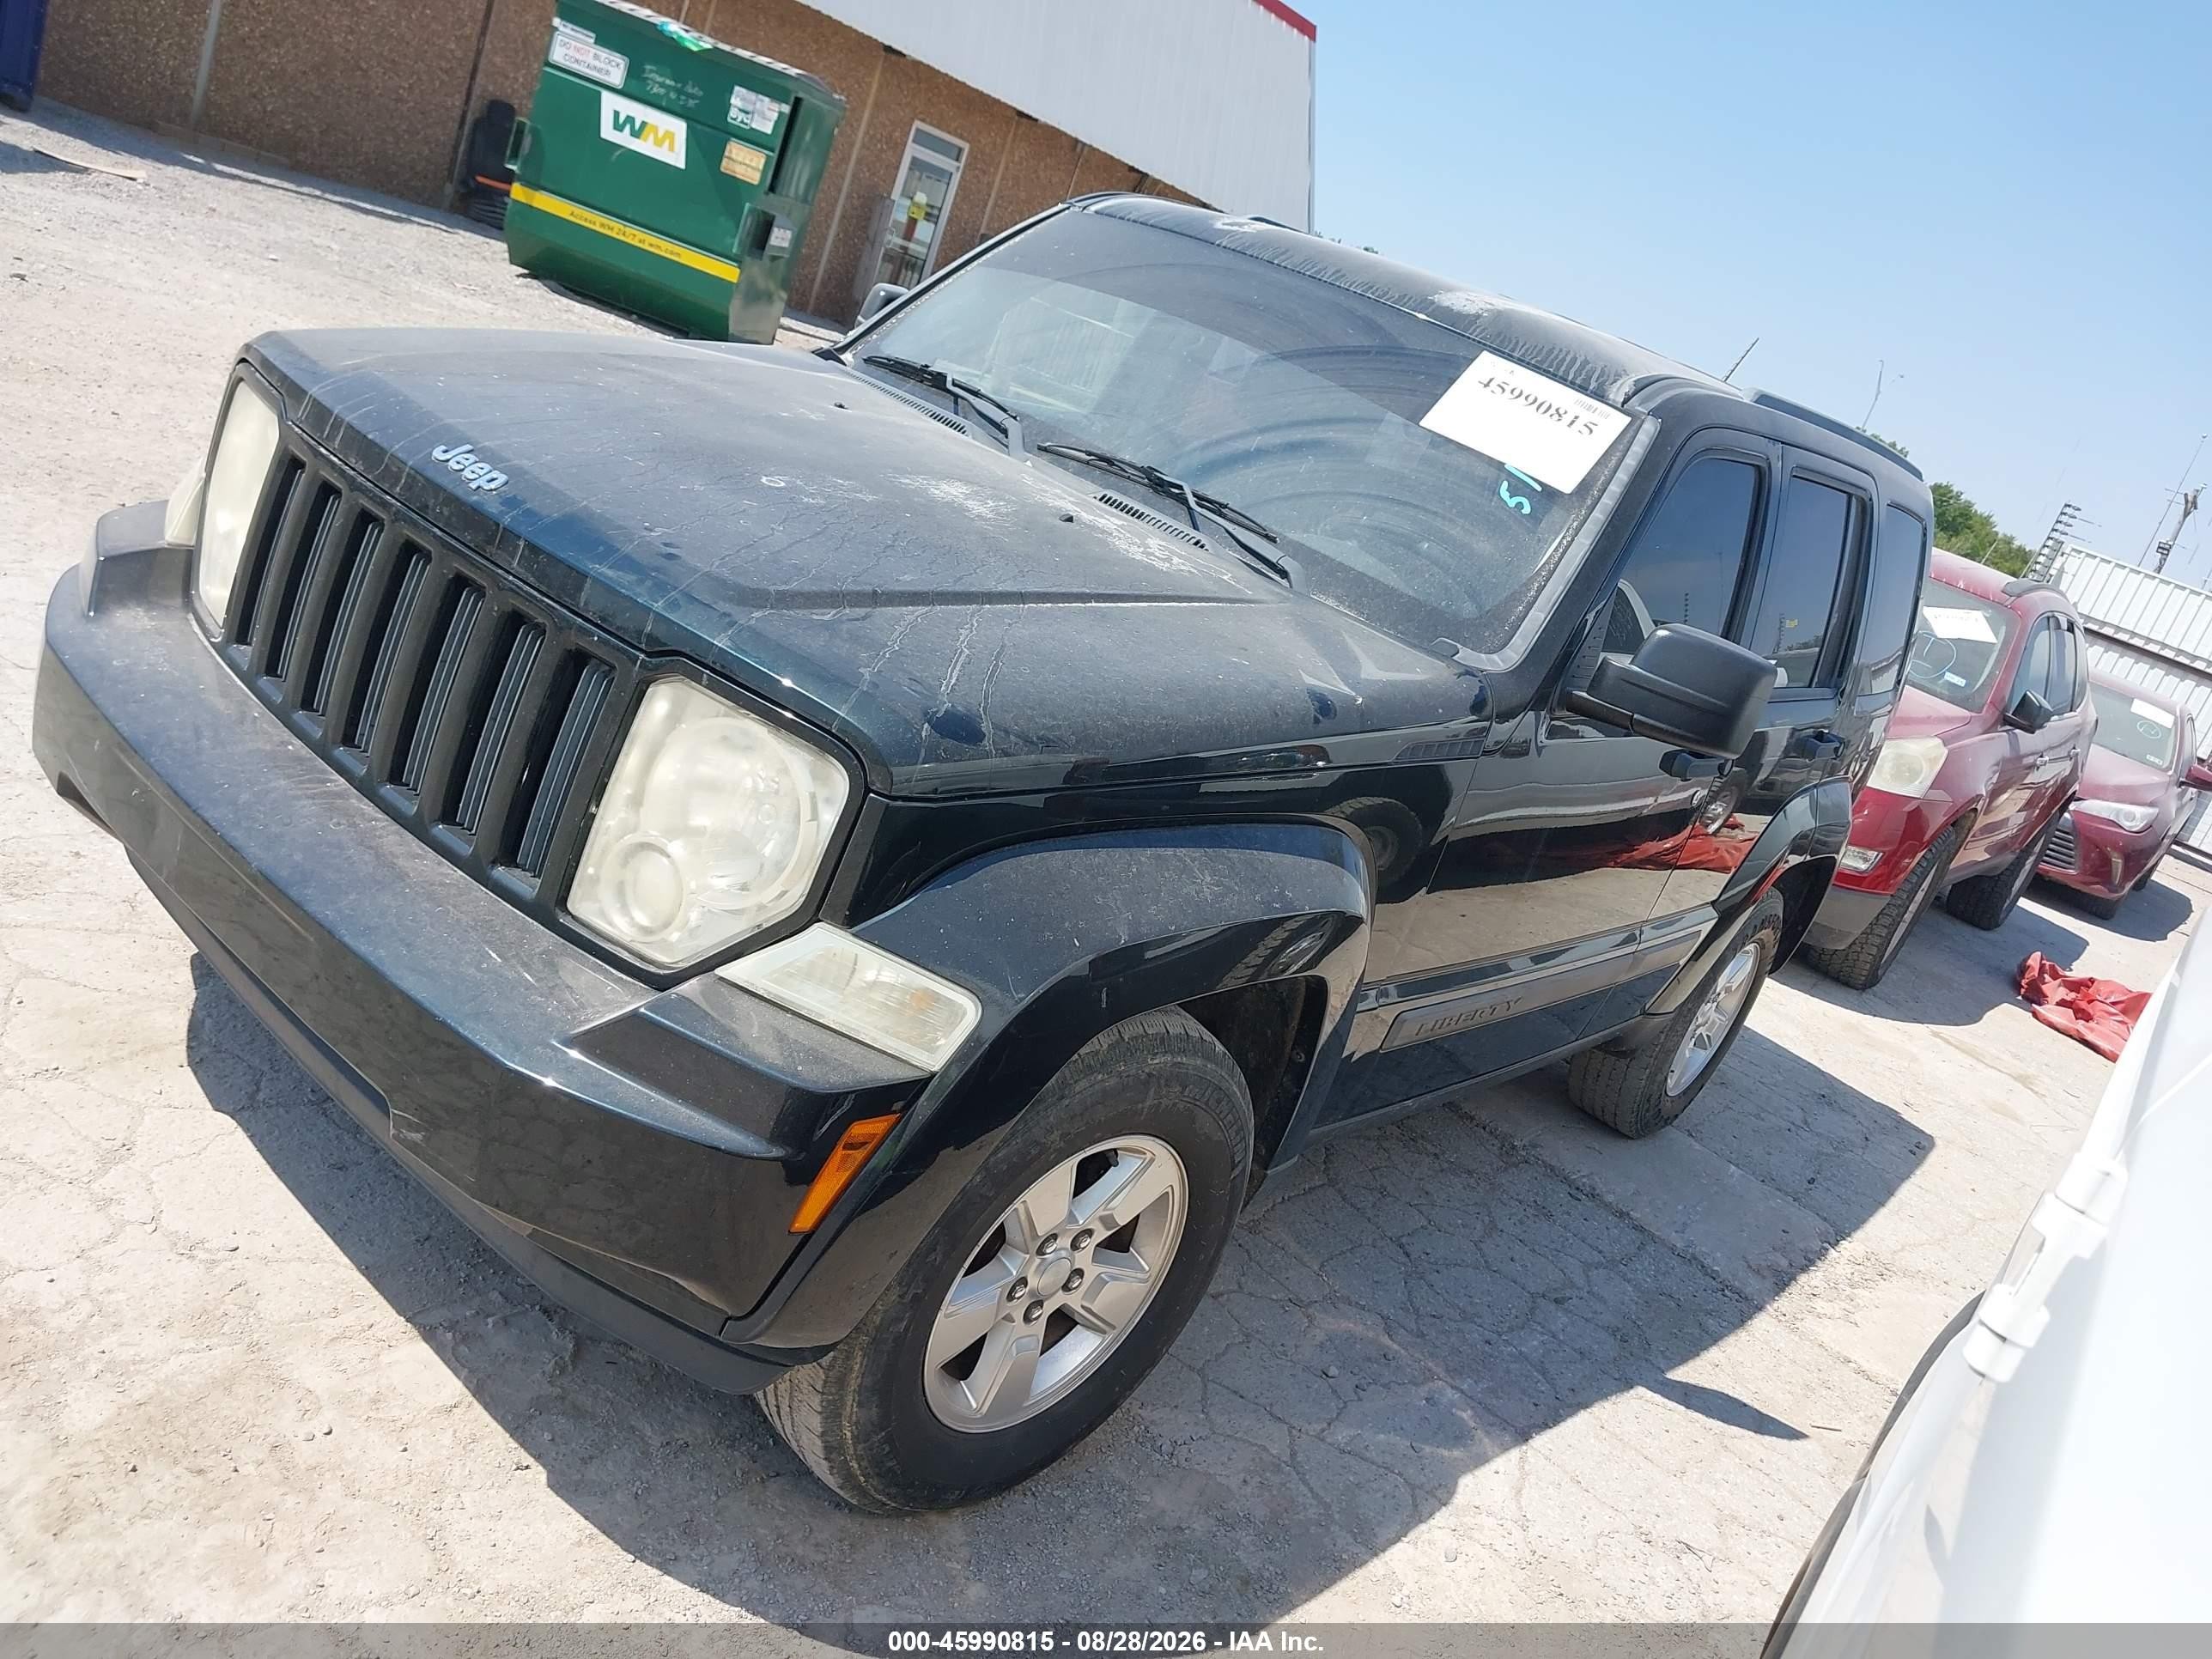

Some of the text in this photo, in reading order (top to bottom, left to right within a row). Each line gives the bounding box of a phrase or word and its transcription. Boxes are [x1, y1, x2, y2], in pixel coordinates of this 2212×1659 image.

[559, 40, 622, 70] DO NOT BLOCK
[563, 52, 611, 76] CONTAINER
[613, 109, 675, 152] WM
[569, 211, 681, 258] Access WM 24/7 at wm.com
[1478, 376, 1599, 436] 45990815
[432, 444, 508, 492] Jeep
[1415, 996, 1524, 1036] LIBERTY
